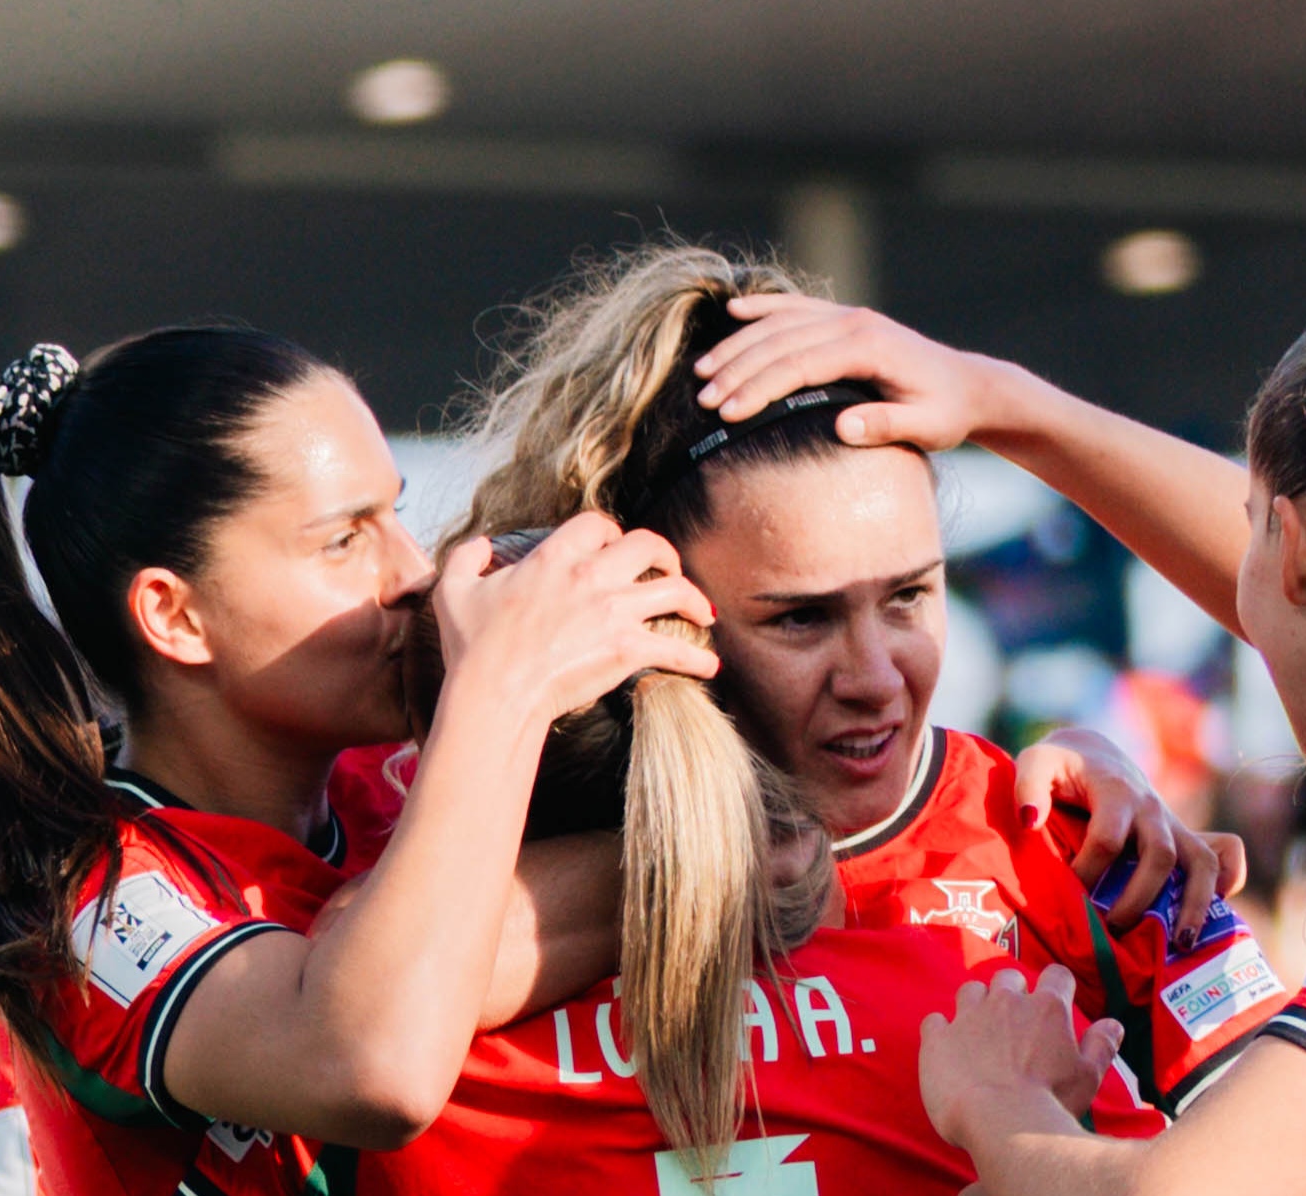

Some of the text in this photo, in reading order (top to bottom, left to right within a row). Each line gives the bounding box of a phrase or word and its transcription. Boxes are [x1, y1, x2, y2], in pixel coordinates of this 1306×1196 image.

[785, 390, 829, 410] PUMA
[689, 428, 729, 460] PUMA
[794, 976, 877, 1058] A.
